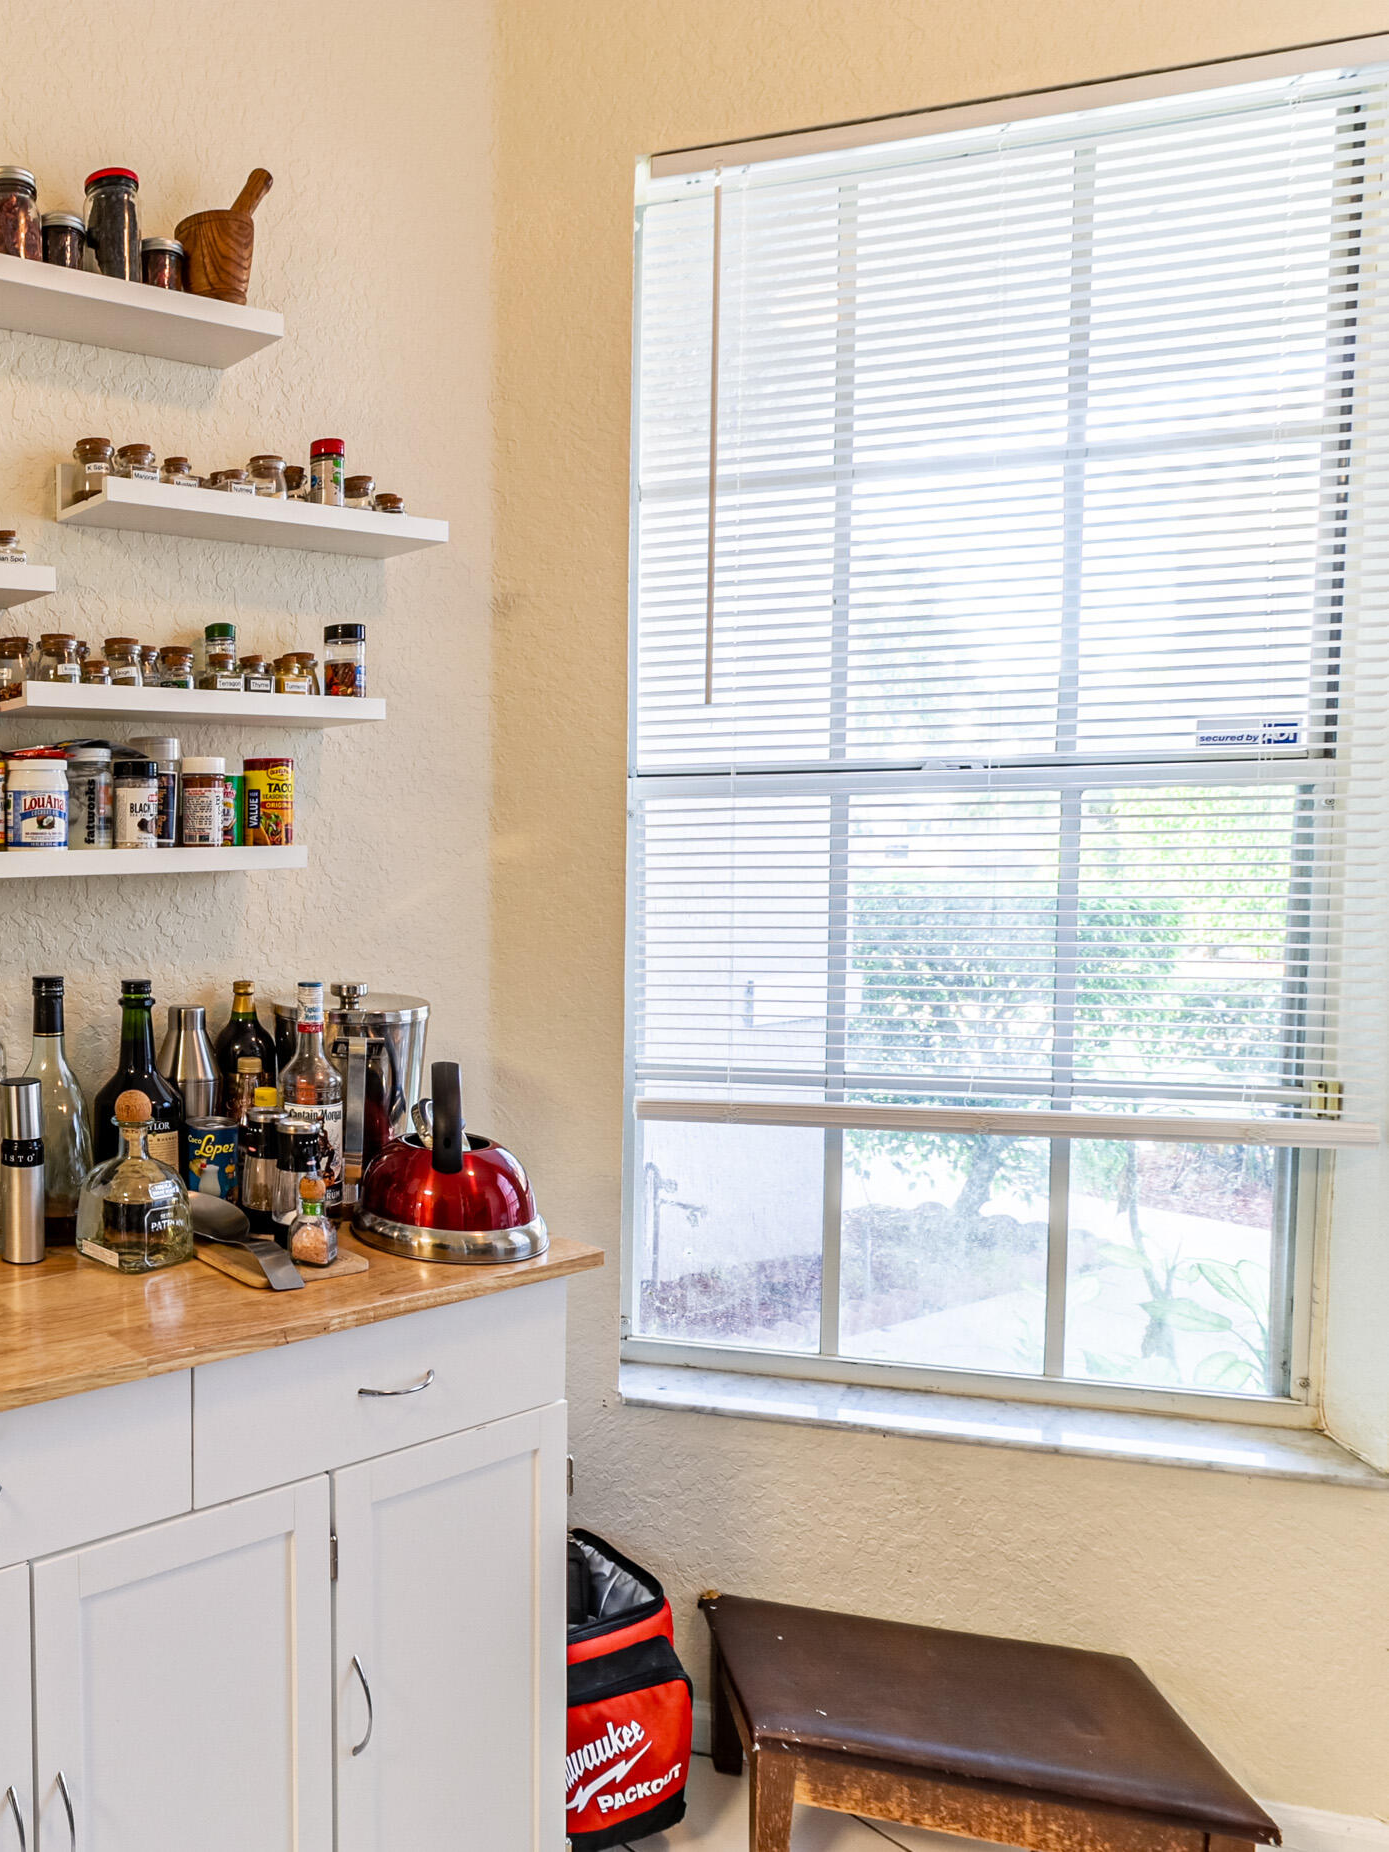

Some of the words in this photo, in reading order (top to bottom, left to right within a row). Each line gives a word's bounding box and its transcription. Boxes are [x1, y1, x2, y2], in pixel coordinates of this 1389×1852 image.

[1199, 733, 1244, 742] secured
[1245, 734, 1259, 744] by
[84, 779, 96, 844] fatworks
[249, 798, 258, 827] VALUE
[187, 1134, 203, 1145] Coco
[597, 1763, 682, 1813] PACKOUT
